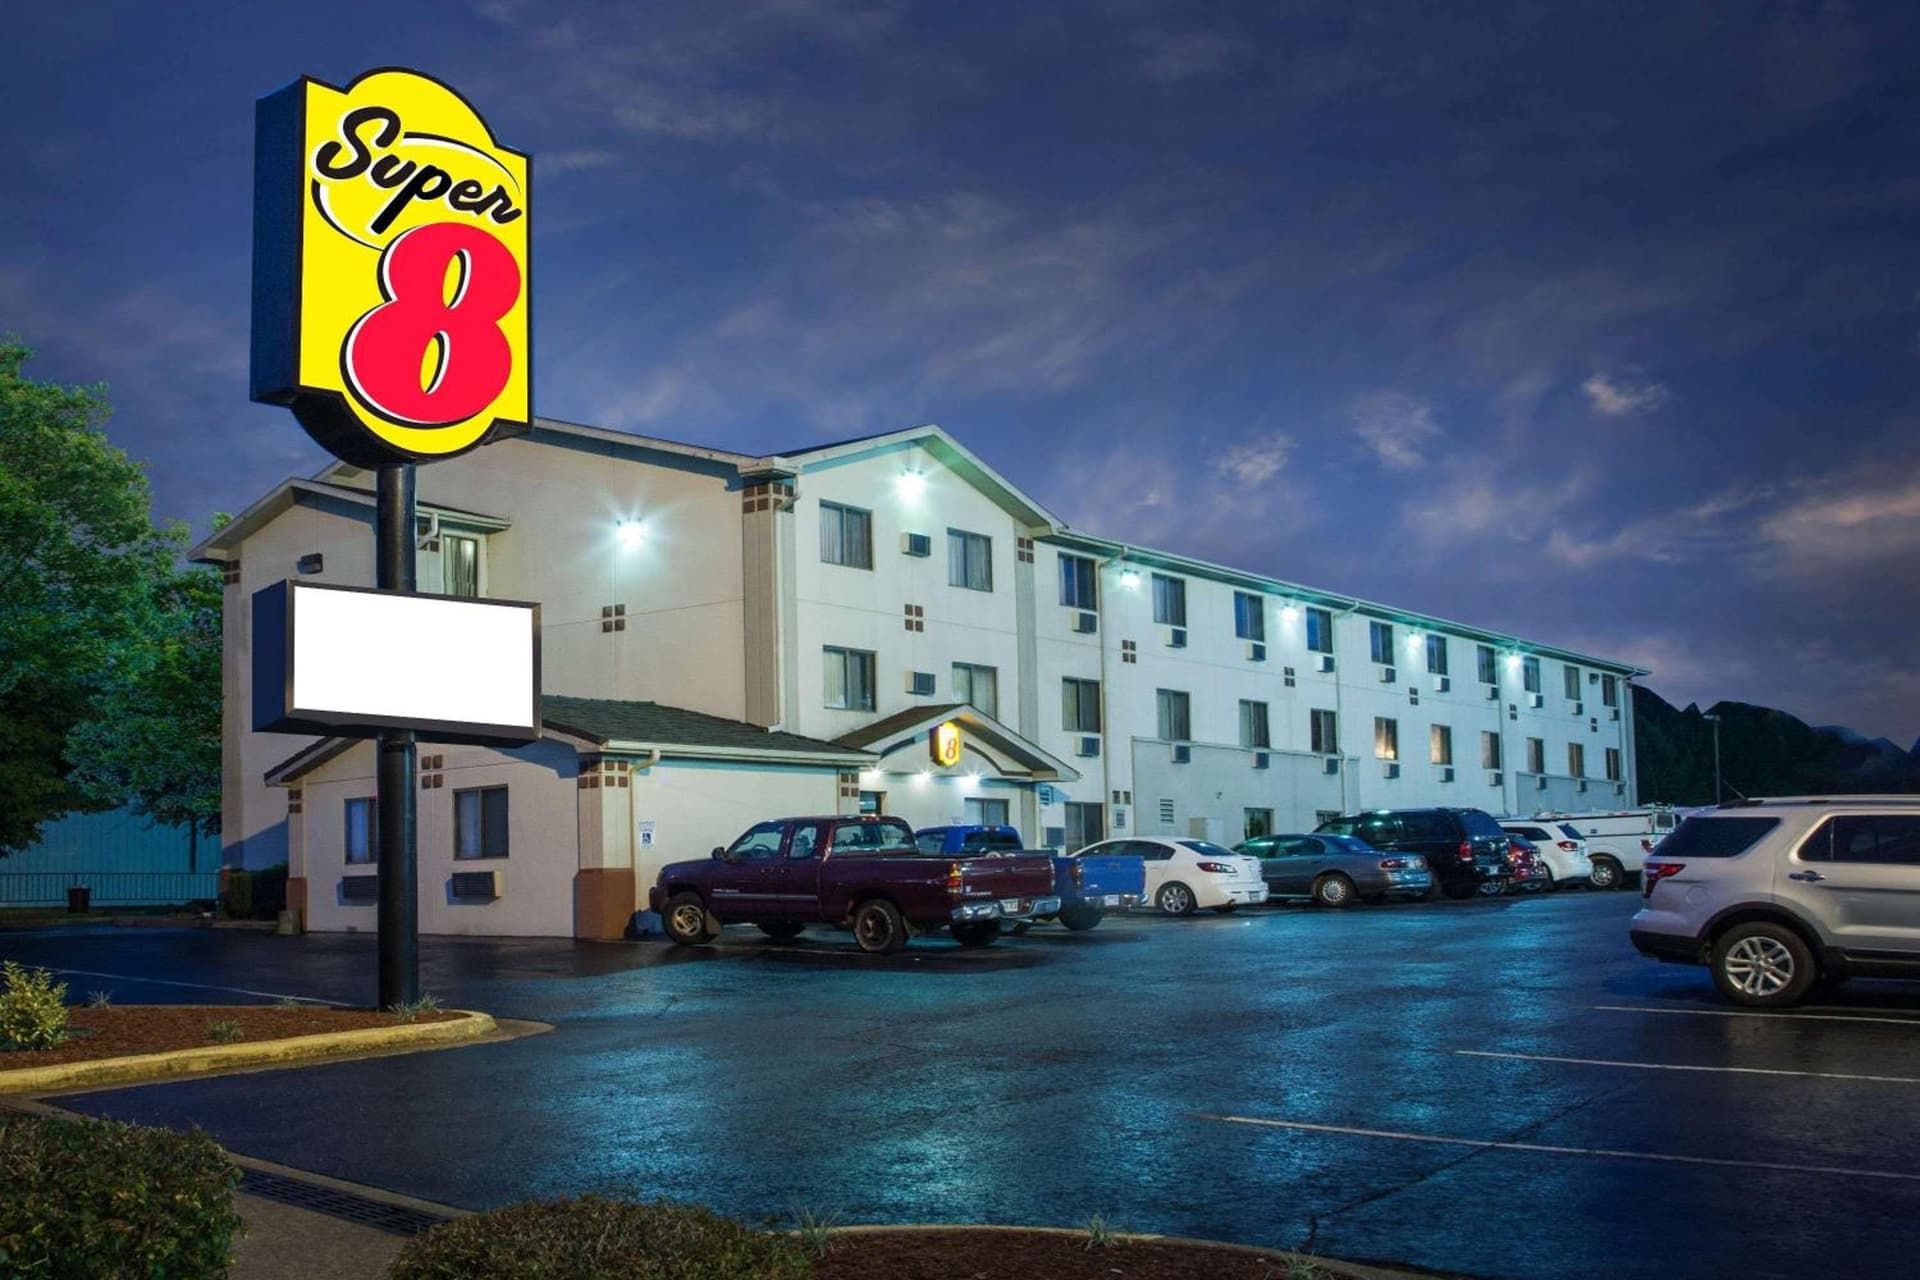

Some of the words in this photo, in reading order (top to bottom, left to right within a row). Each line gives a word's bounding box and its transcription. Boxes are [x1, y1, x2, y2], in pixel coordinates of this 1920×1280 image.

[314, 105, 523, 236] Super
[340, 221, 521, 429] 8
[945, 736, 958, 760] 8
